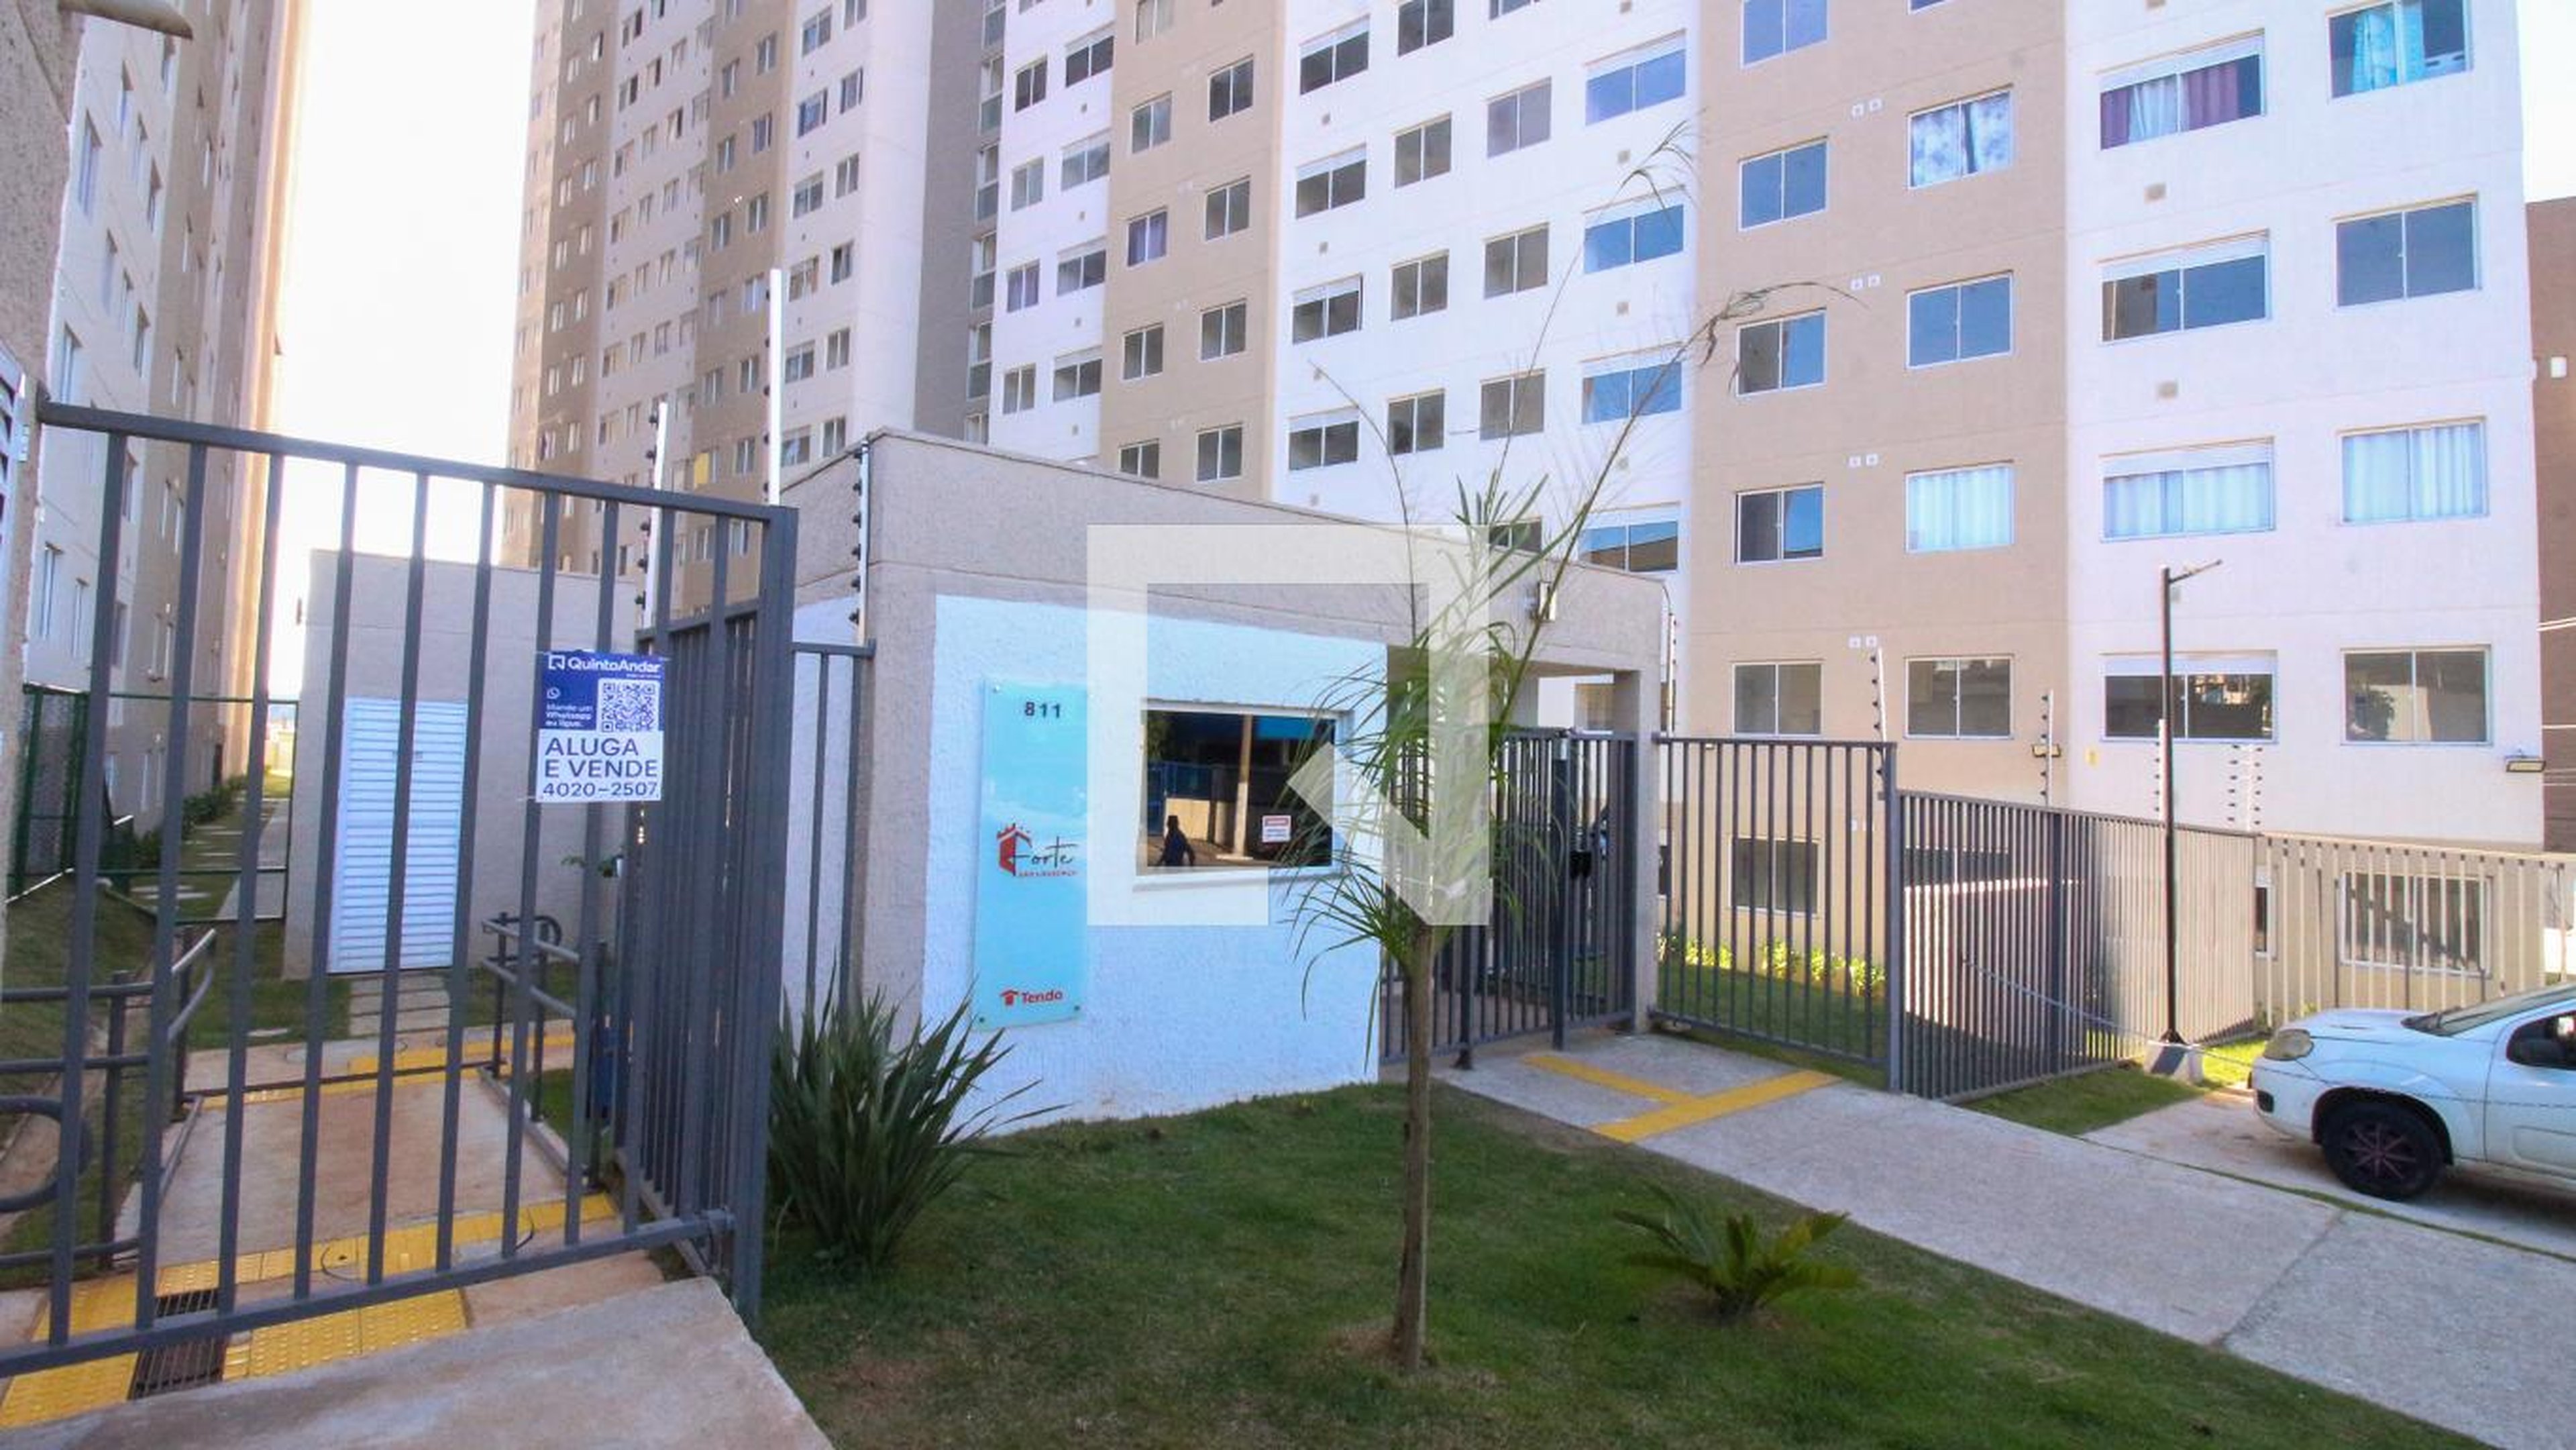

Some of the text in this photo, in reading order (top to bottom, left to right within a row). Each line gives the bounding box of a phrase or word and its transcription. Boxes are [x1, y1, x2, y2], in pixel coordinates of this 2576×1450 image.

[568, 657, 661, 672] QuintoAndar
[1024, 702, 1060, 718] 811
[545, 737, 639, 756] ALUGA
[545, 759, 657, 778] E VENDE
[543, 782, 657, 797] 4020-2507
[1011, 823, 1079, 876] Forte
